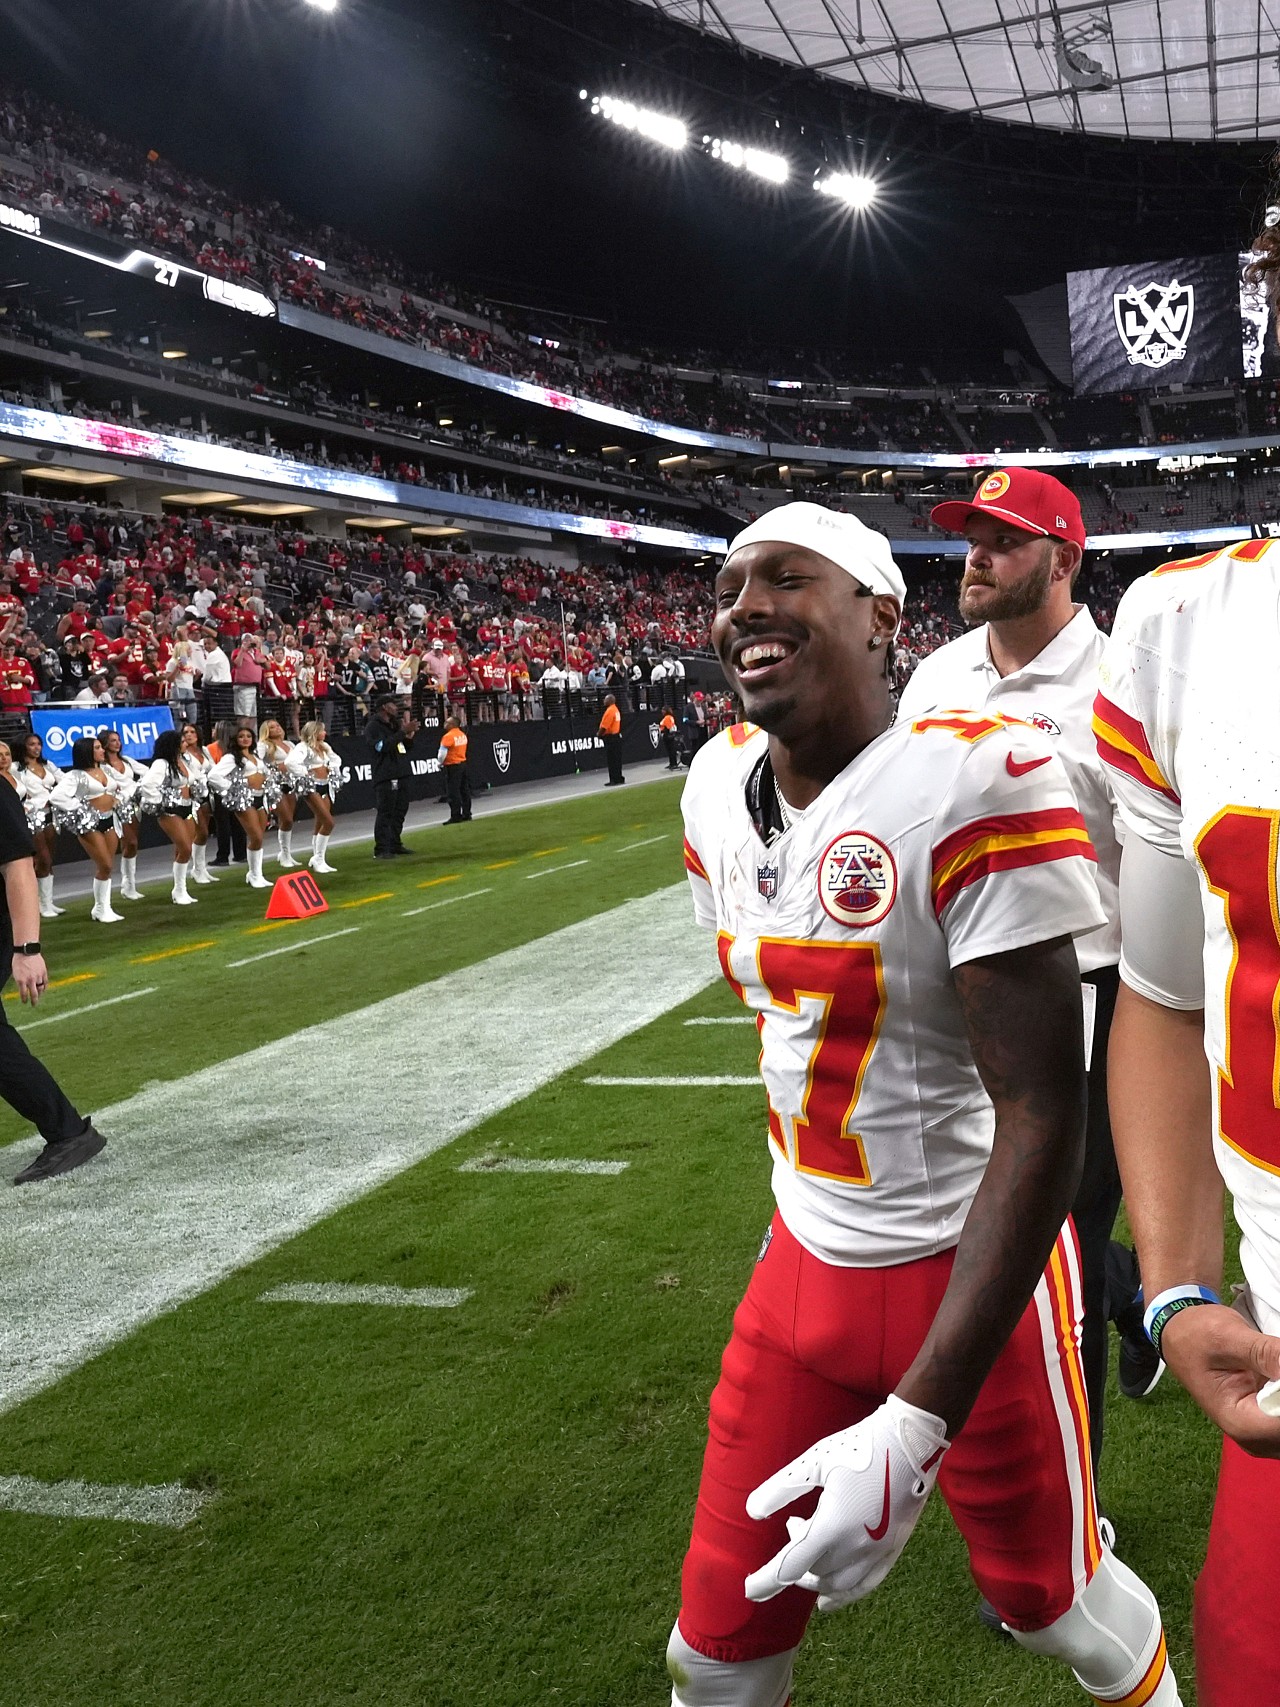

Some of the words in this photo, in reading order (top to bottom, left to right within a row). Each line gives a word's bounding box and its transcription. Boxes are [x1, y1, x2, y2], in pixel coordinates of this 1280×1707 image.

[154, 260, 179, 287] 27
[341, 670, 353, 685] 17
[425, 718, 439, 727] C110
[552, 740, 567, 754] LAS
[568, 737, 592, 752] VEGAS
[288, 876, 323, 911] 10
